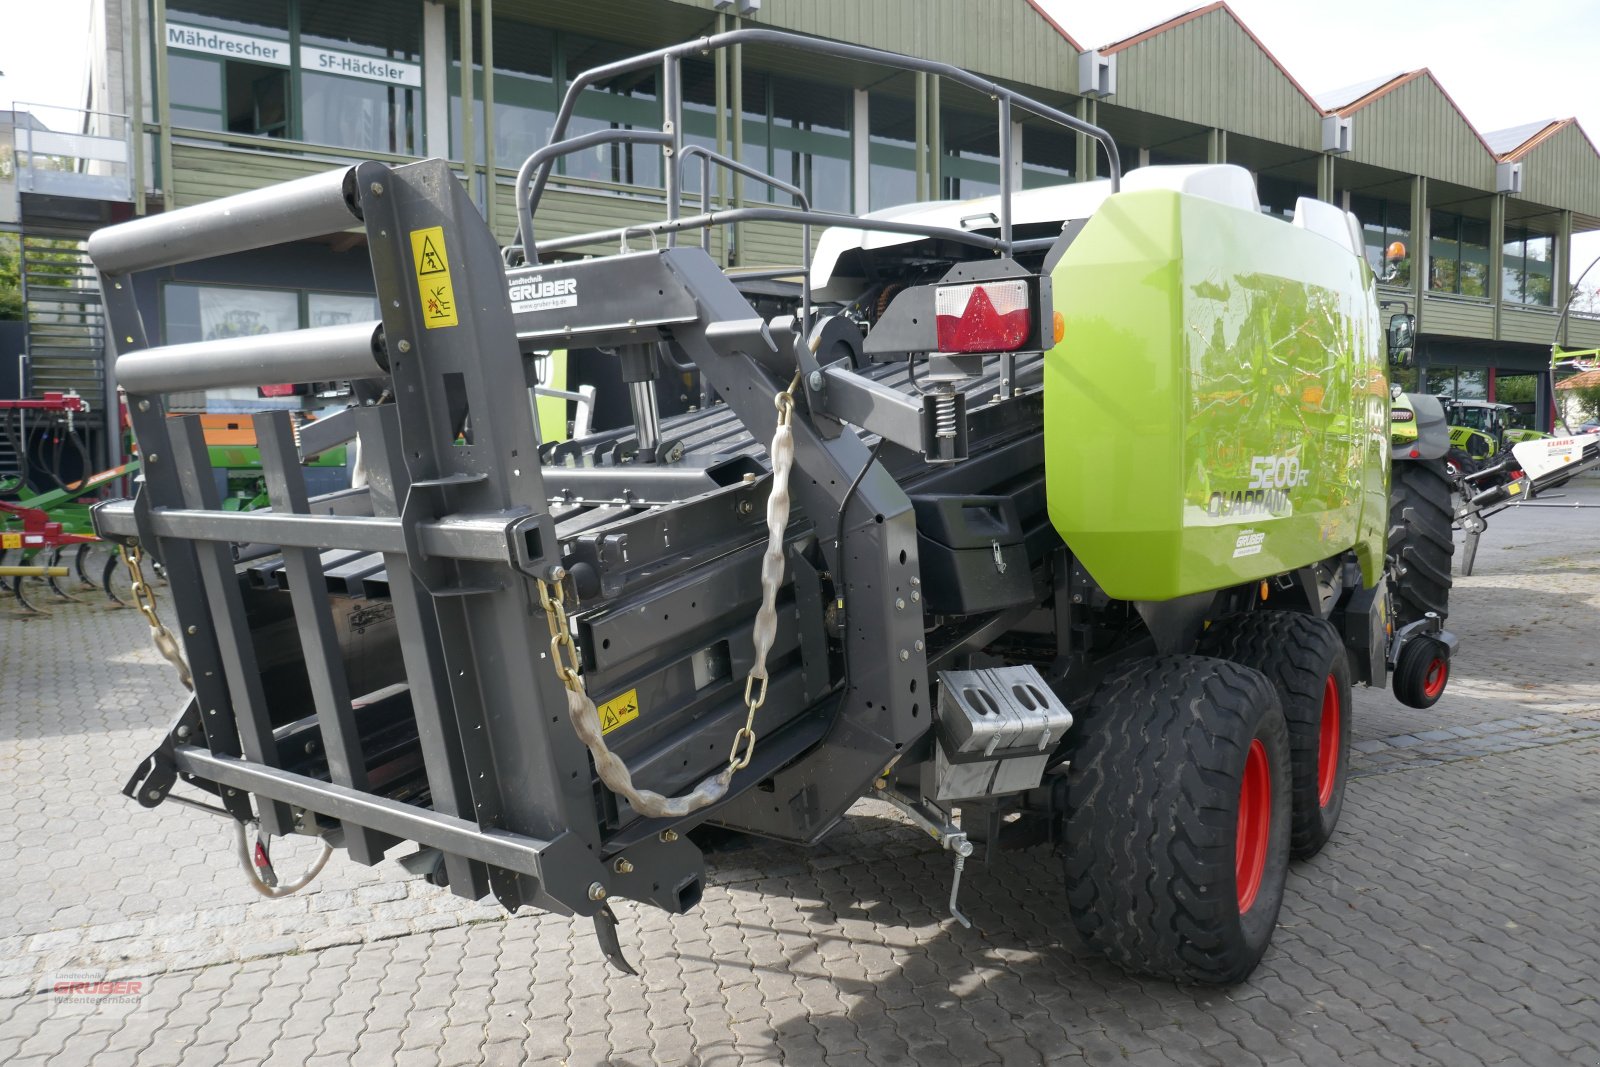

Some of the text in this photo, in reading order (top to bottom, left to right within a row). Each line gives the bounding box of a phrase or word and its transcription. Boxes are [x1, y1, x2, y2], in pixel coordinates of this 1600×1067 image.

[168, 28, 279, 59] Mähdrescher
[319, 54, 405, 80] SF-Häcksler
[508, 278, 577, 301] GRUBER
[509, 275, 543, 286] Landtechnik
[1547, 439, 1575, 448] CLAAS
[1248, 455, 1299, 489] 5200
[1207, 488, 1290, 517] QUADRANT
[1236, 532, 1265, 548] GRUBER
